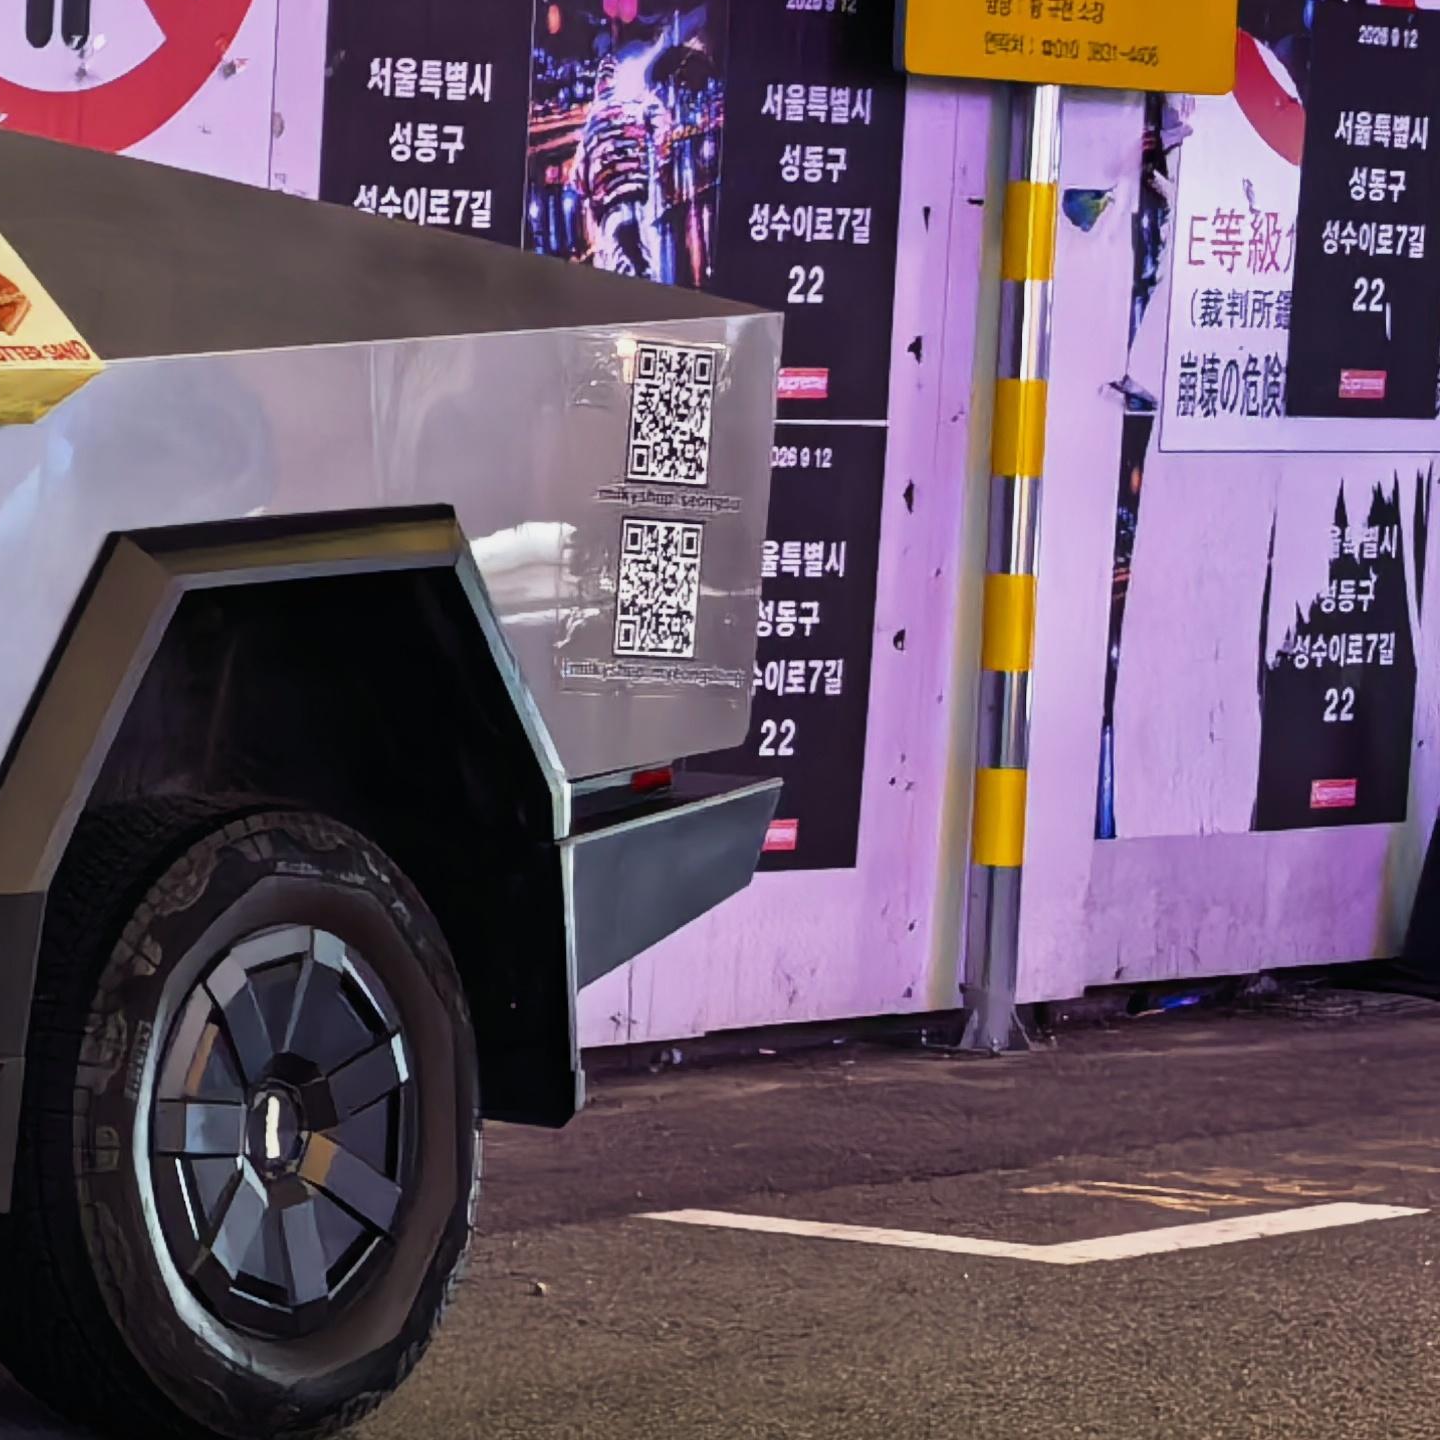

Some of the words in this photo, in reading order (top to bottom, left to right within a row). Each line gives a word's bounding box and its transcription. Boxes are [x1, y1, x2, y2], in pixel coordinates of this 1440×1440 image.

[1403, 28, 1418, 48] 12
[366, 56, 493, 102] 서울특별시
[761, 83, 873, 125] 서울특별시
[389, 121, 465, 164] 성동구
[1334, 110, 1430, 151] 서울특별시
[779, 144, 848, 185] 성동구
[1349, 166, 1407, 202] 성동구
[748, 204, 871, 245] 성수이로7길
[1321, 220, 1425, 259] 성수이로7길
[787, 265, 825, 304] 22
[1352, 277, 1385, 312] 22
[771, 446, 797, 468] 026
[800, 447, 810, 468] 9
[814, 448, 832, 468] 12
[761, 540, 847, 578] 울특별시
[1292, 632, 1396, 669] 성수이로7길
[752, 658, 843, 697] 이로7길
[1322, 686, 1355, 722] 22
[758, 718, 796, 757] 22
